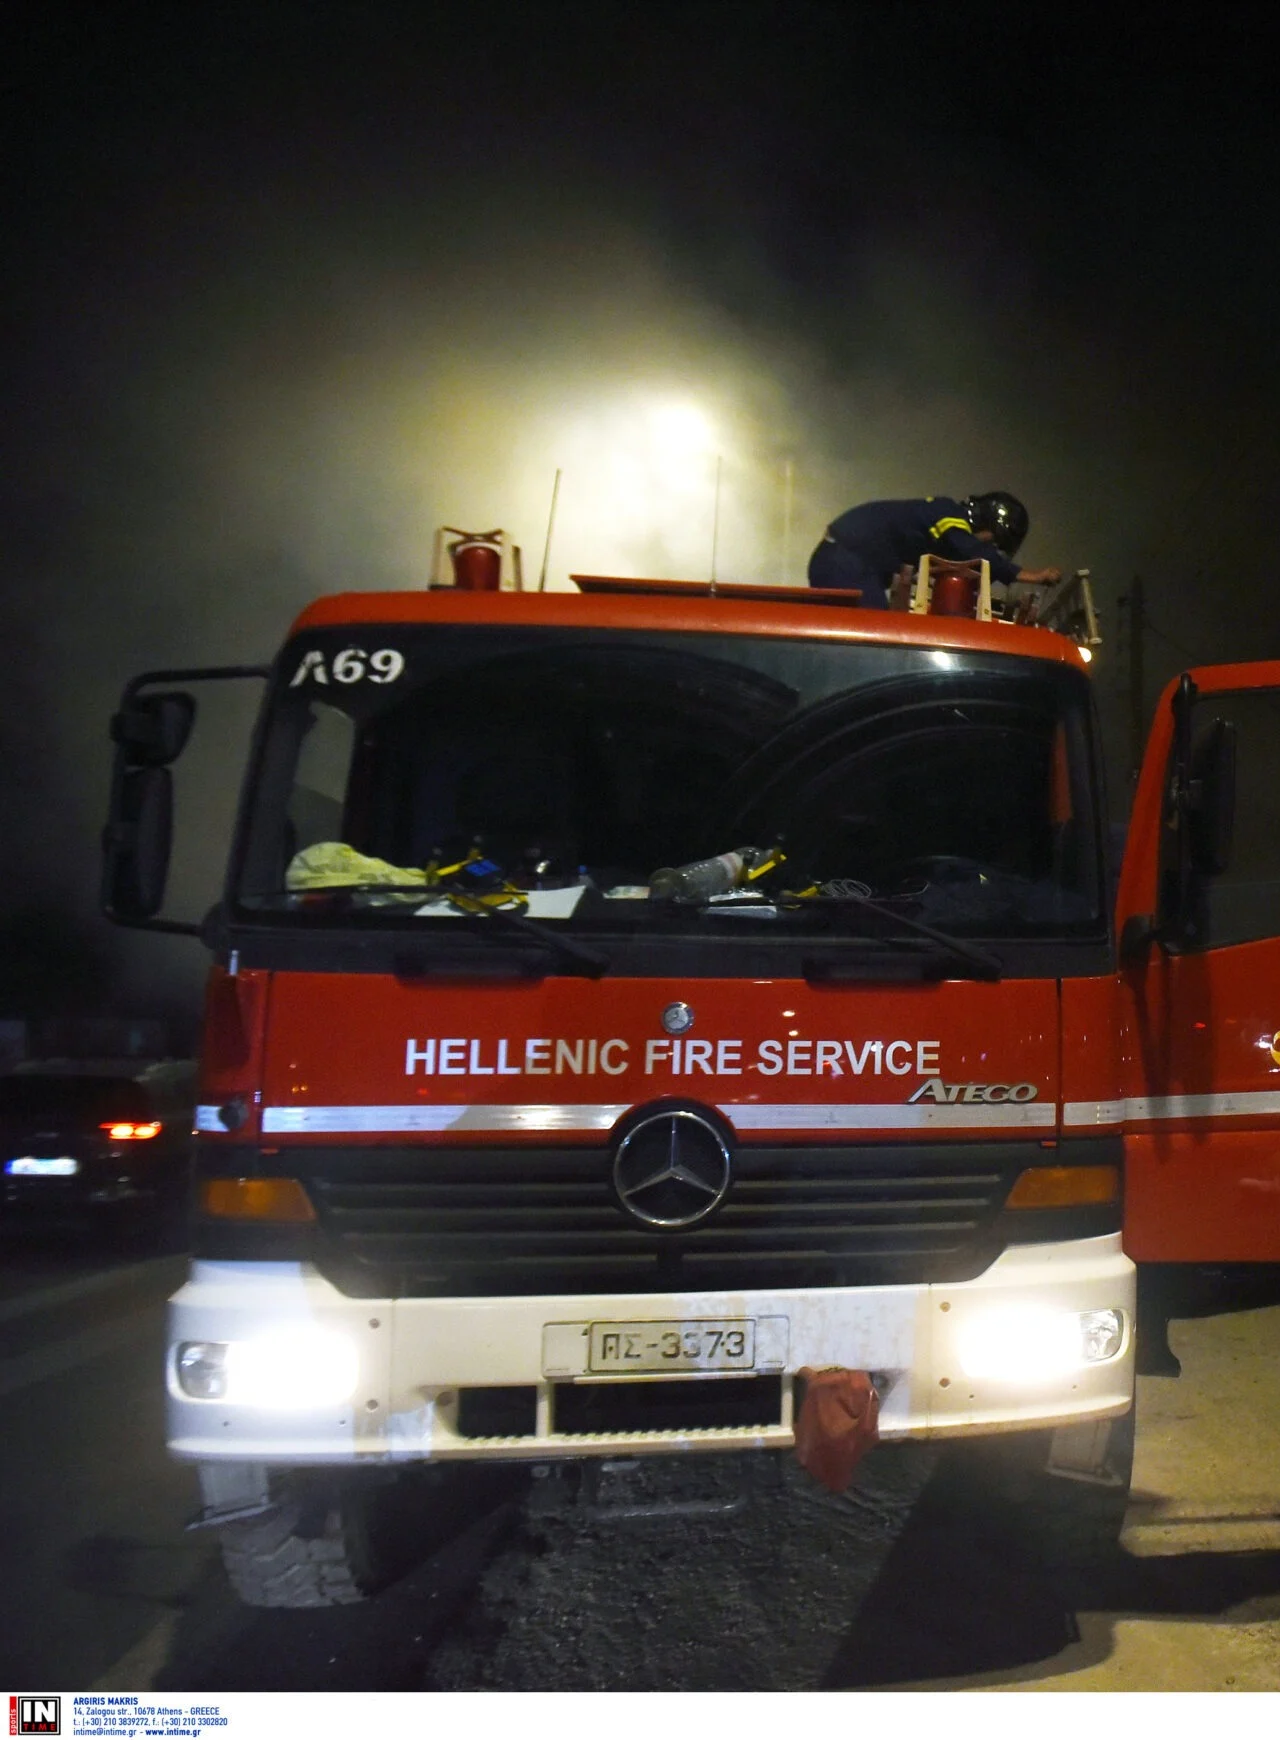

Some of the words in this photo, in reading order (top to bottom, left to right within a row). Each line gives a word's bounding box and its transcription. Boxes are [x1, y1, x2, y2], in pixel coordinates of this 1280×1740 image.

[405, 1039, 629, 1075] HELLENIC
[645, 1039, 742, 1075] FIRE
[757, 1040, 940, 1075] SERVICE
